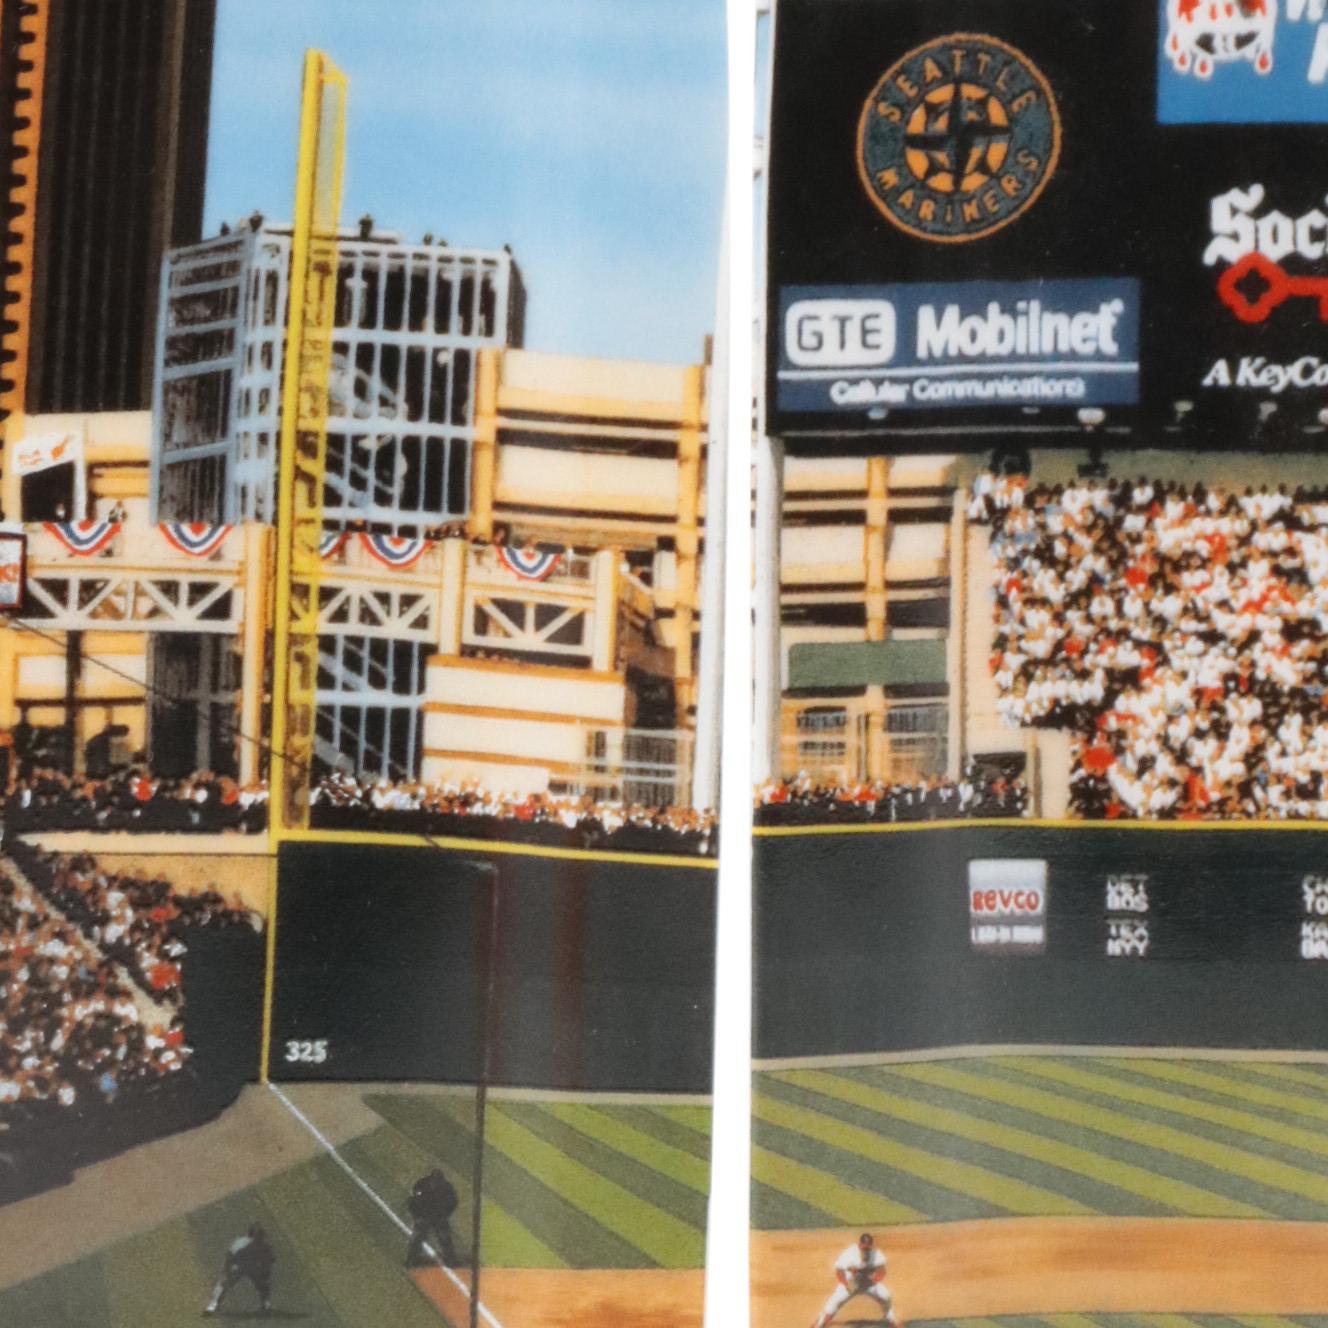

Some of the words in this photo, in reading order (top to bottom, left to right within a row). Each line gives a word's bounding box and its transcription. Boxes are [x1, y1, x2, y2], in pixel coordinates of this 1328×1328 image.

[877, 49, 1037, 121] SEATTLE
[876, 149, 1039, 222] MARINERS
[1203, 182, 1328, 266] Soc
[796, 313, 882, 352] GTE
[916, 299, 1120, 359] Mobilnet
[829, 378, 910, 405] Cellular
[913, 376, 1087, 402] Communications
[1201, 358, 1232, 387] A
[285, 1040, 328, 1064] 325
